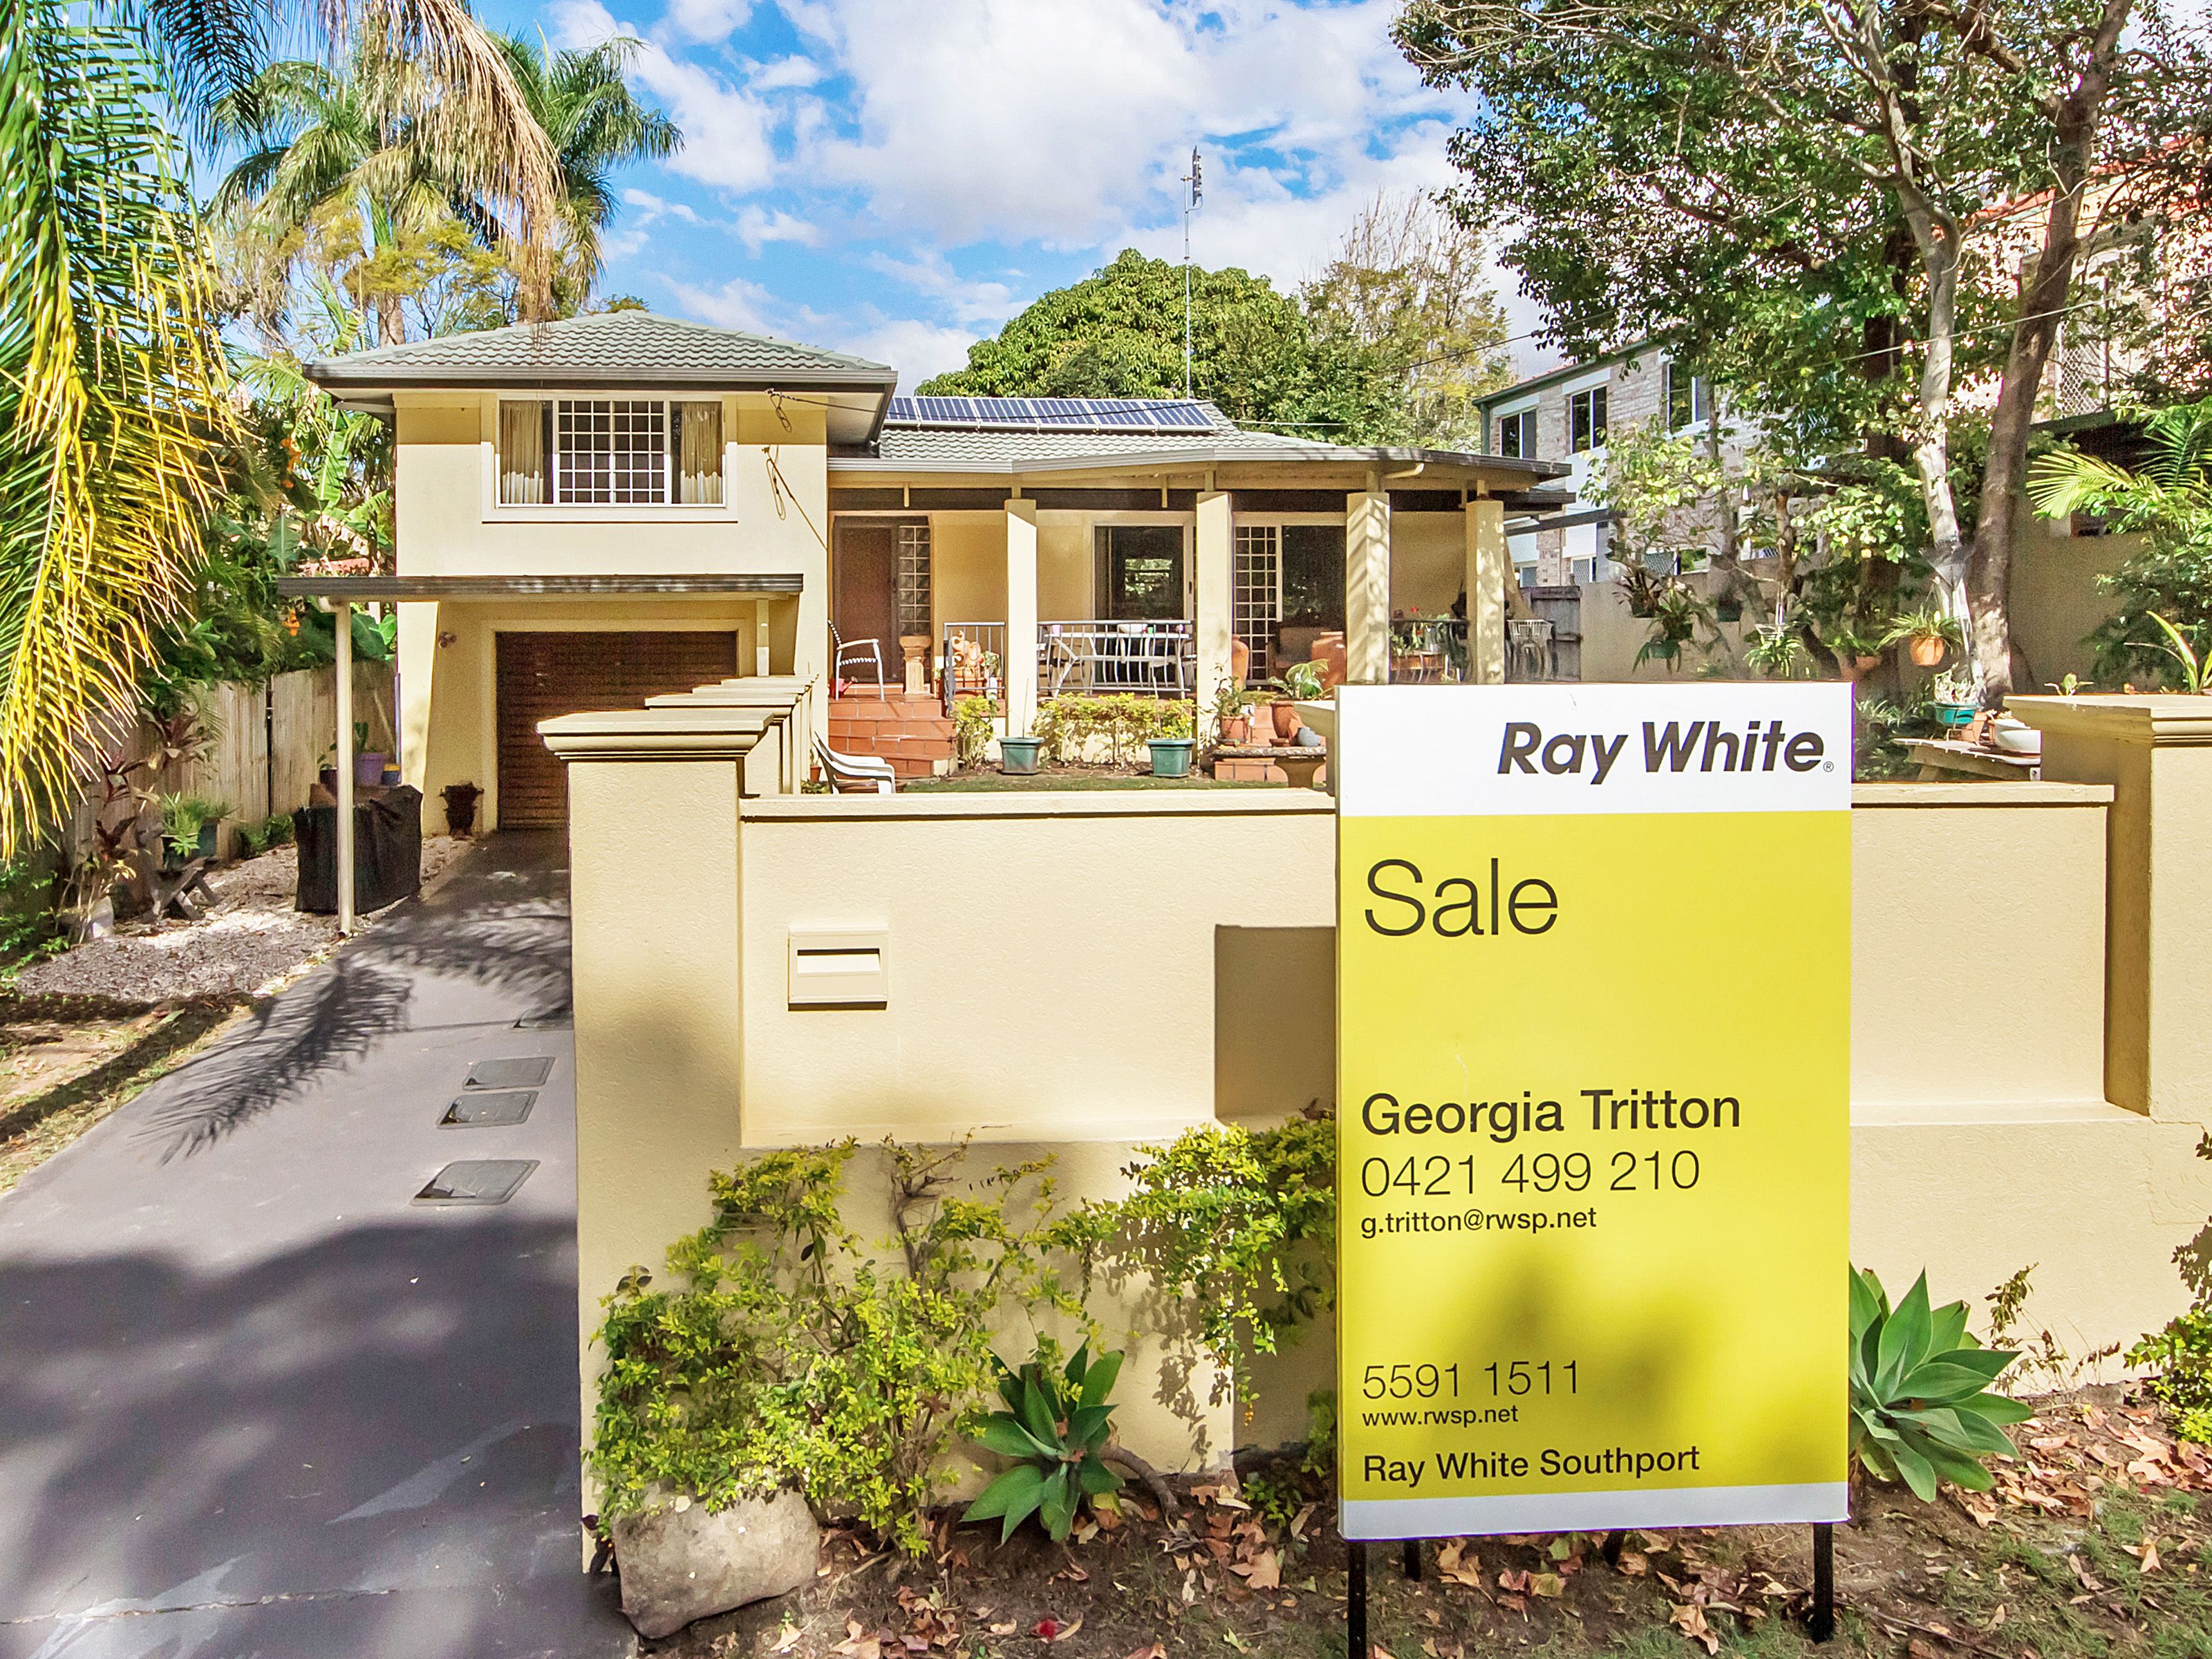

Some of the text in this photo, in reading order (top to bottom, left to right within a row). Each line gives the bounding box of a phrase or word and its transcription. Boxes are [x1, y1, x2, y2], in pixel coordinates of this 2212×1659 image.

[1497, 722, 1629, 785] Ray
[1365, 857, 1558, 938] Sale
[1362, 1088, 1740, 1143] Georgia Tritton
[1361, 1150, 1700, 1197] 0421 499 210
[1360, 1207, 1597, 1239] g.tritton@rwsp.net
[1362, 1360, 1577, 1400] 5591 1511
[1362, 1404, 1519, 1429] www.rwsp.net
[1364, 1445, 1700, 1488] Ray White Southport
